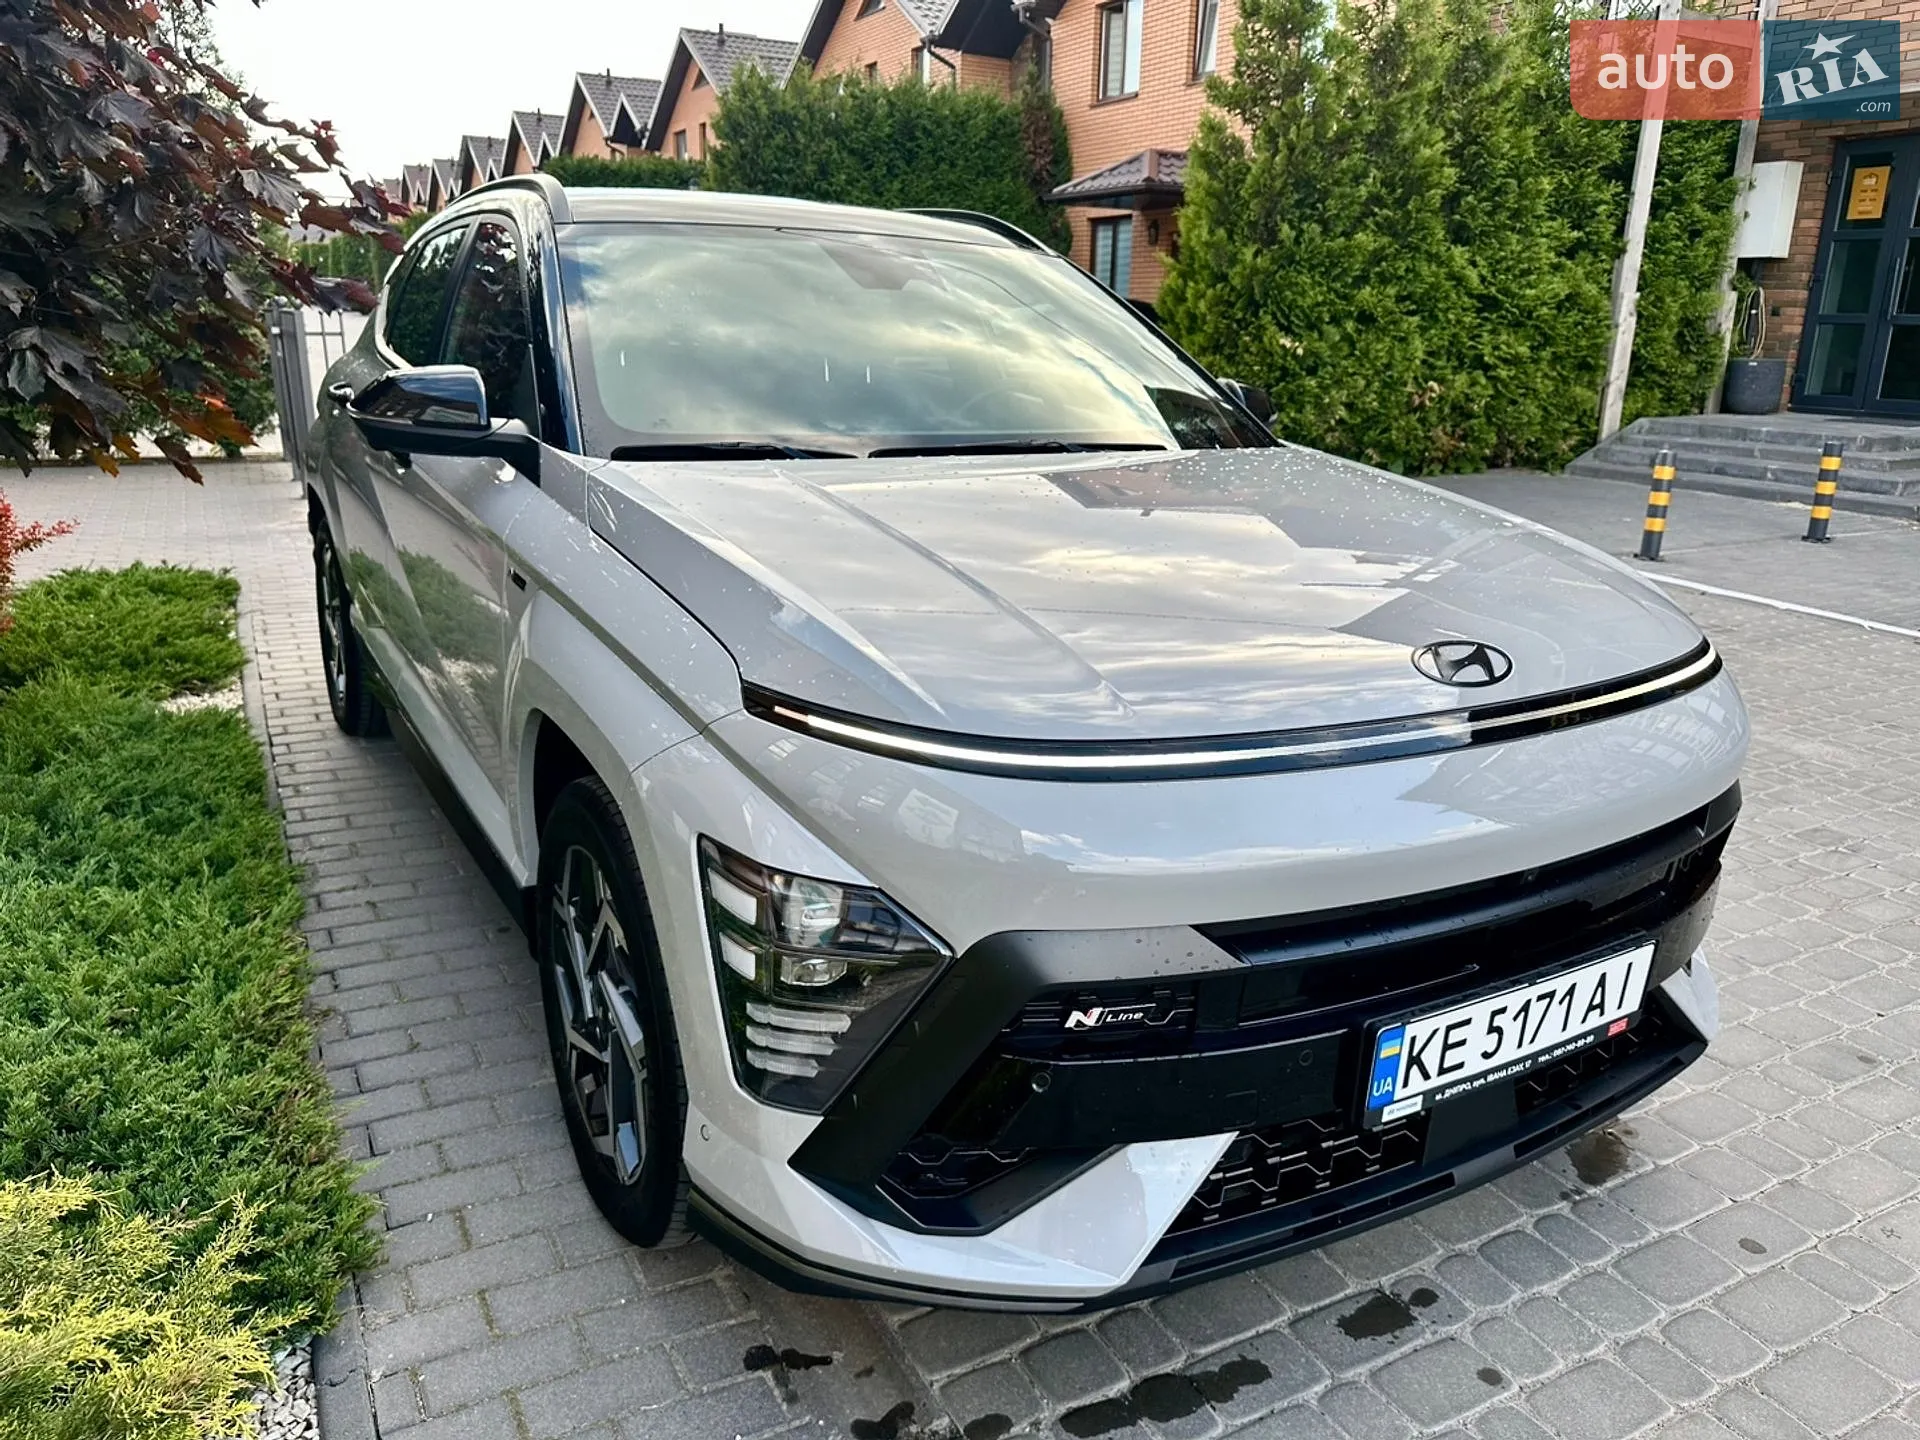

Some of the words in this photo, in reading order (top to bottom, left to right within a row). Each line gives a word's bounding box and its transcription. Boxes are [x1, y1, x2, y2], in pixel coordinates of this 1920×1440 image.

[1402, 1017, 1473, 1089] KE
[1480, 982, 1577, 1060] 5171
[1580, 961, 1634, 1025] AI
[1373, 1076, 1393, 1097] UA
